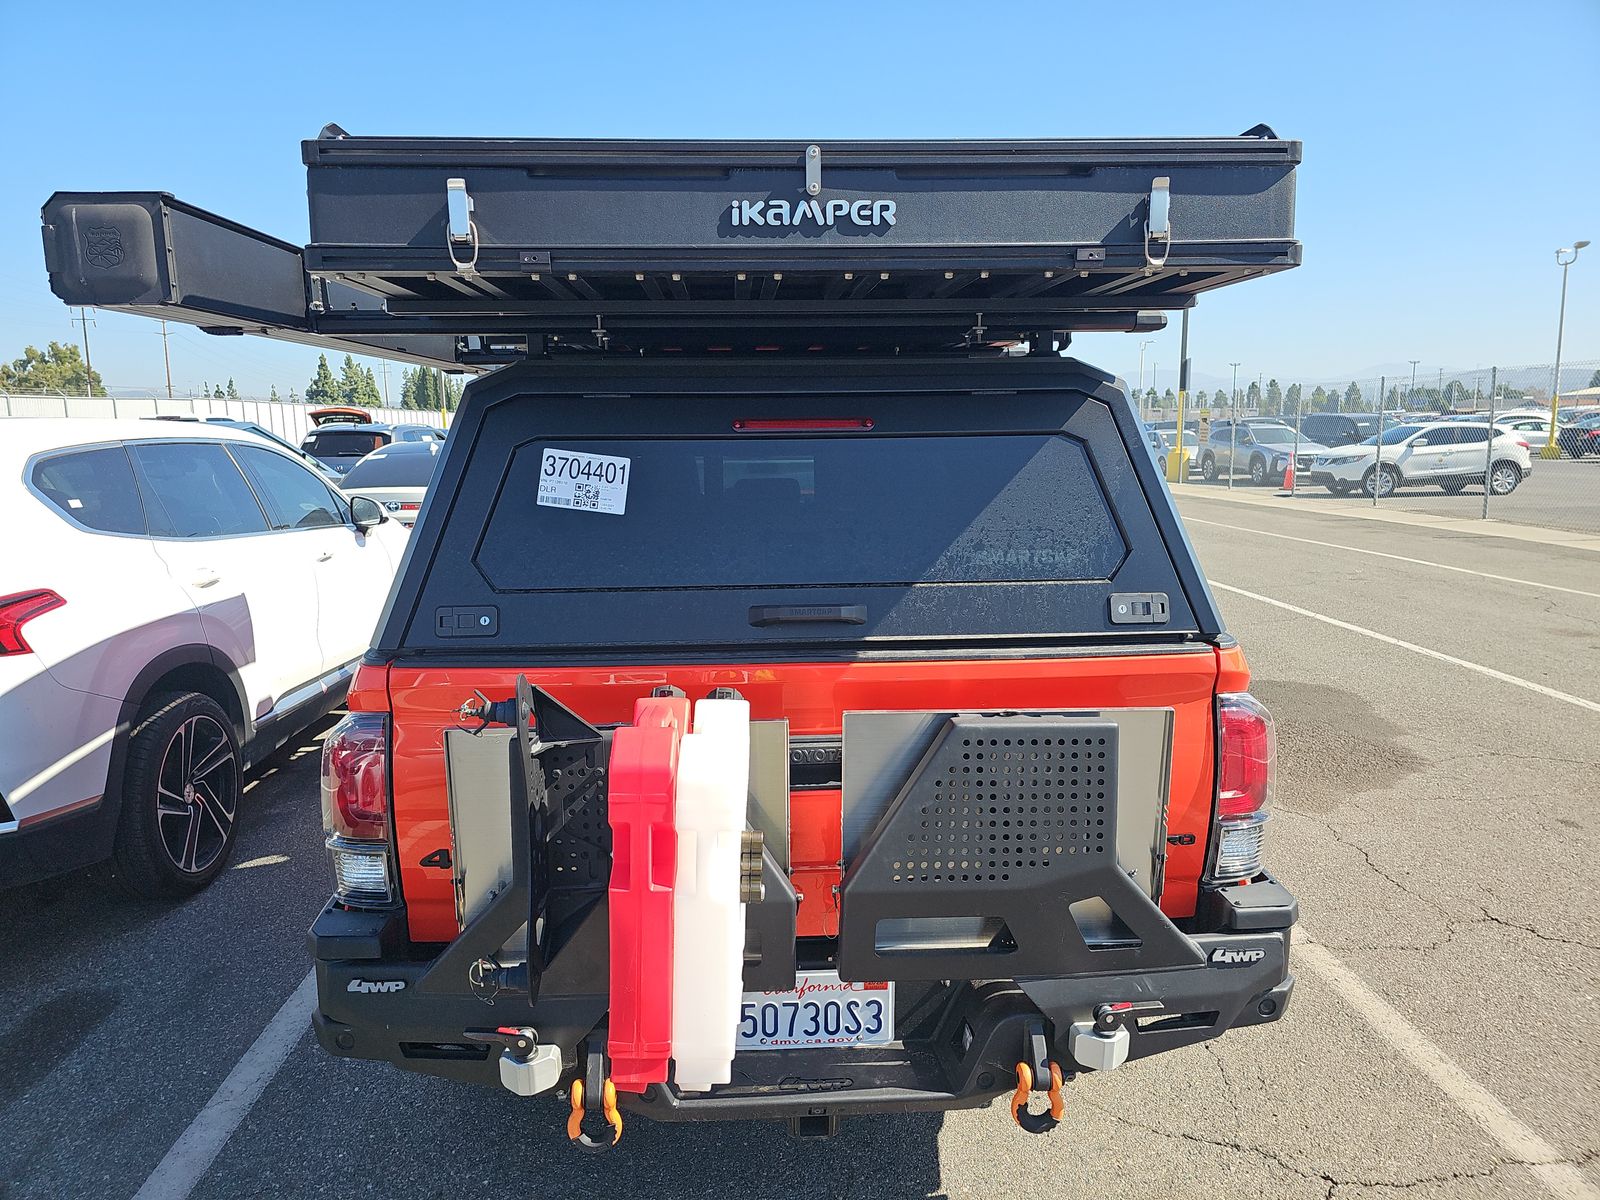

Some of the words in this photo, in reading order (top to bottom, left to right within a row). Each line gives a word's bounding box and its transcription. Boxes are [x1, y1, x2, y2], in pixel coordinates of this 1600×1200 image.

[544, 455, 626, 485] 3704401
[790, 748, 842, 762] OYOTA
[741, 1000, 883, 1038] 50730S3
[770, 1037, 853, 1045] dmv.ca.gov
